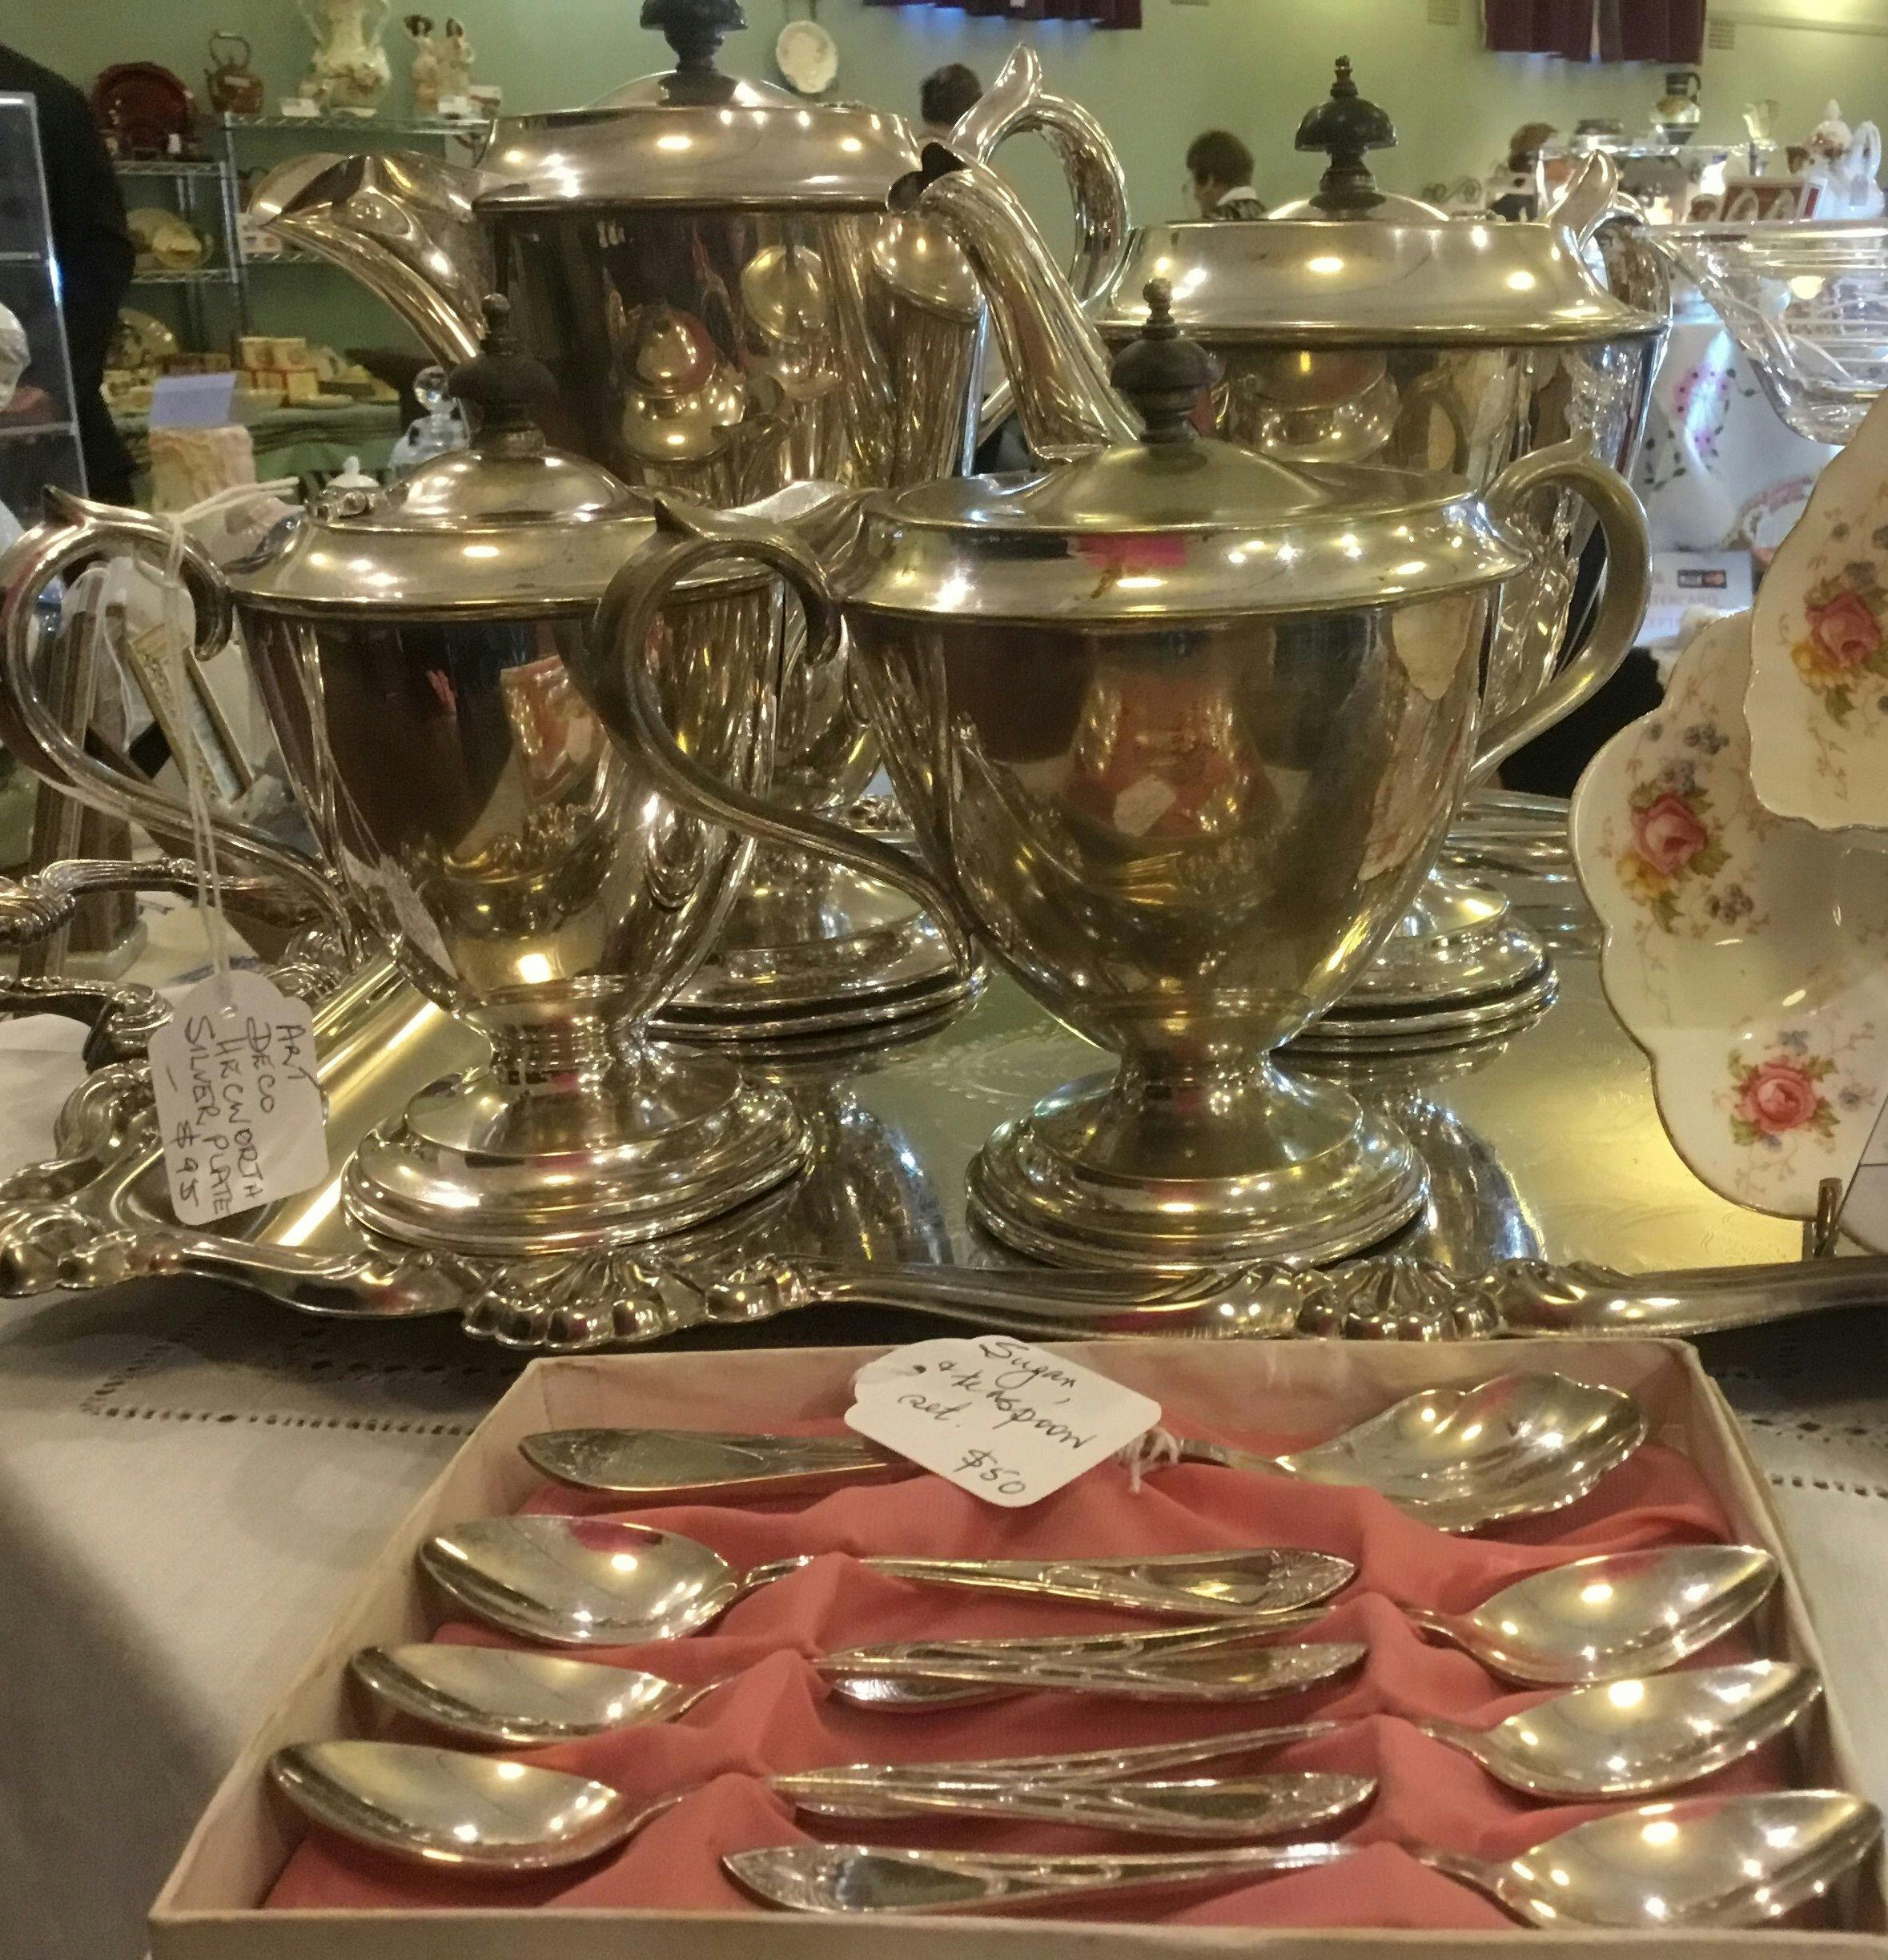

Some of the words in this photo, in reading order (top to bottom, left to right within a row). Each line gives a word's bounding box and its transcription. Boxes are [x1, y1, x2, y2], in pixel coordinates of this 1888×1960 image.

[184, 1015, 221, 1126] SILVER
[247, 1017, 275, 1113] DECO
[277, 1025, 321, 1091] ART
[202, 1134, 233, 1215] PLATE
[952, 1448, 1027, 1495] $50
